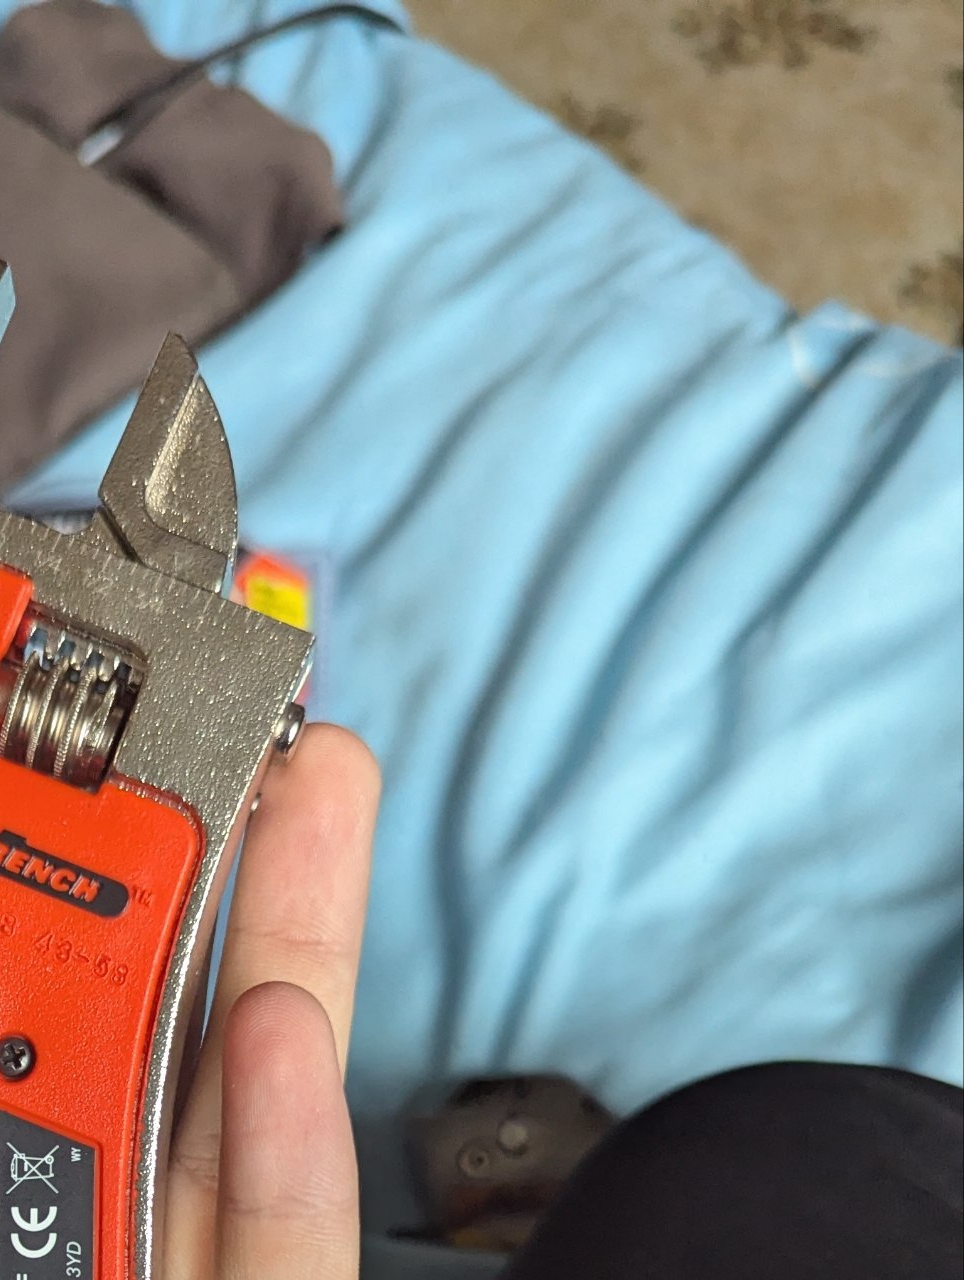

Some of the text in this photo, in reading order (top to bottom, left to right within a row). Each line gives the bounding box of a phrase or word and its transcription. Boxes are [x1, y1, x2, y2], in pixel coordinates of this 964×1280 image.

[71, 1147, 82, 1163] WY
[10, 1206, 58, 1259] CE
[66, 1240, 82, 1278] 3YD
